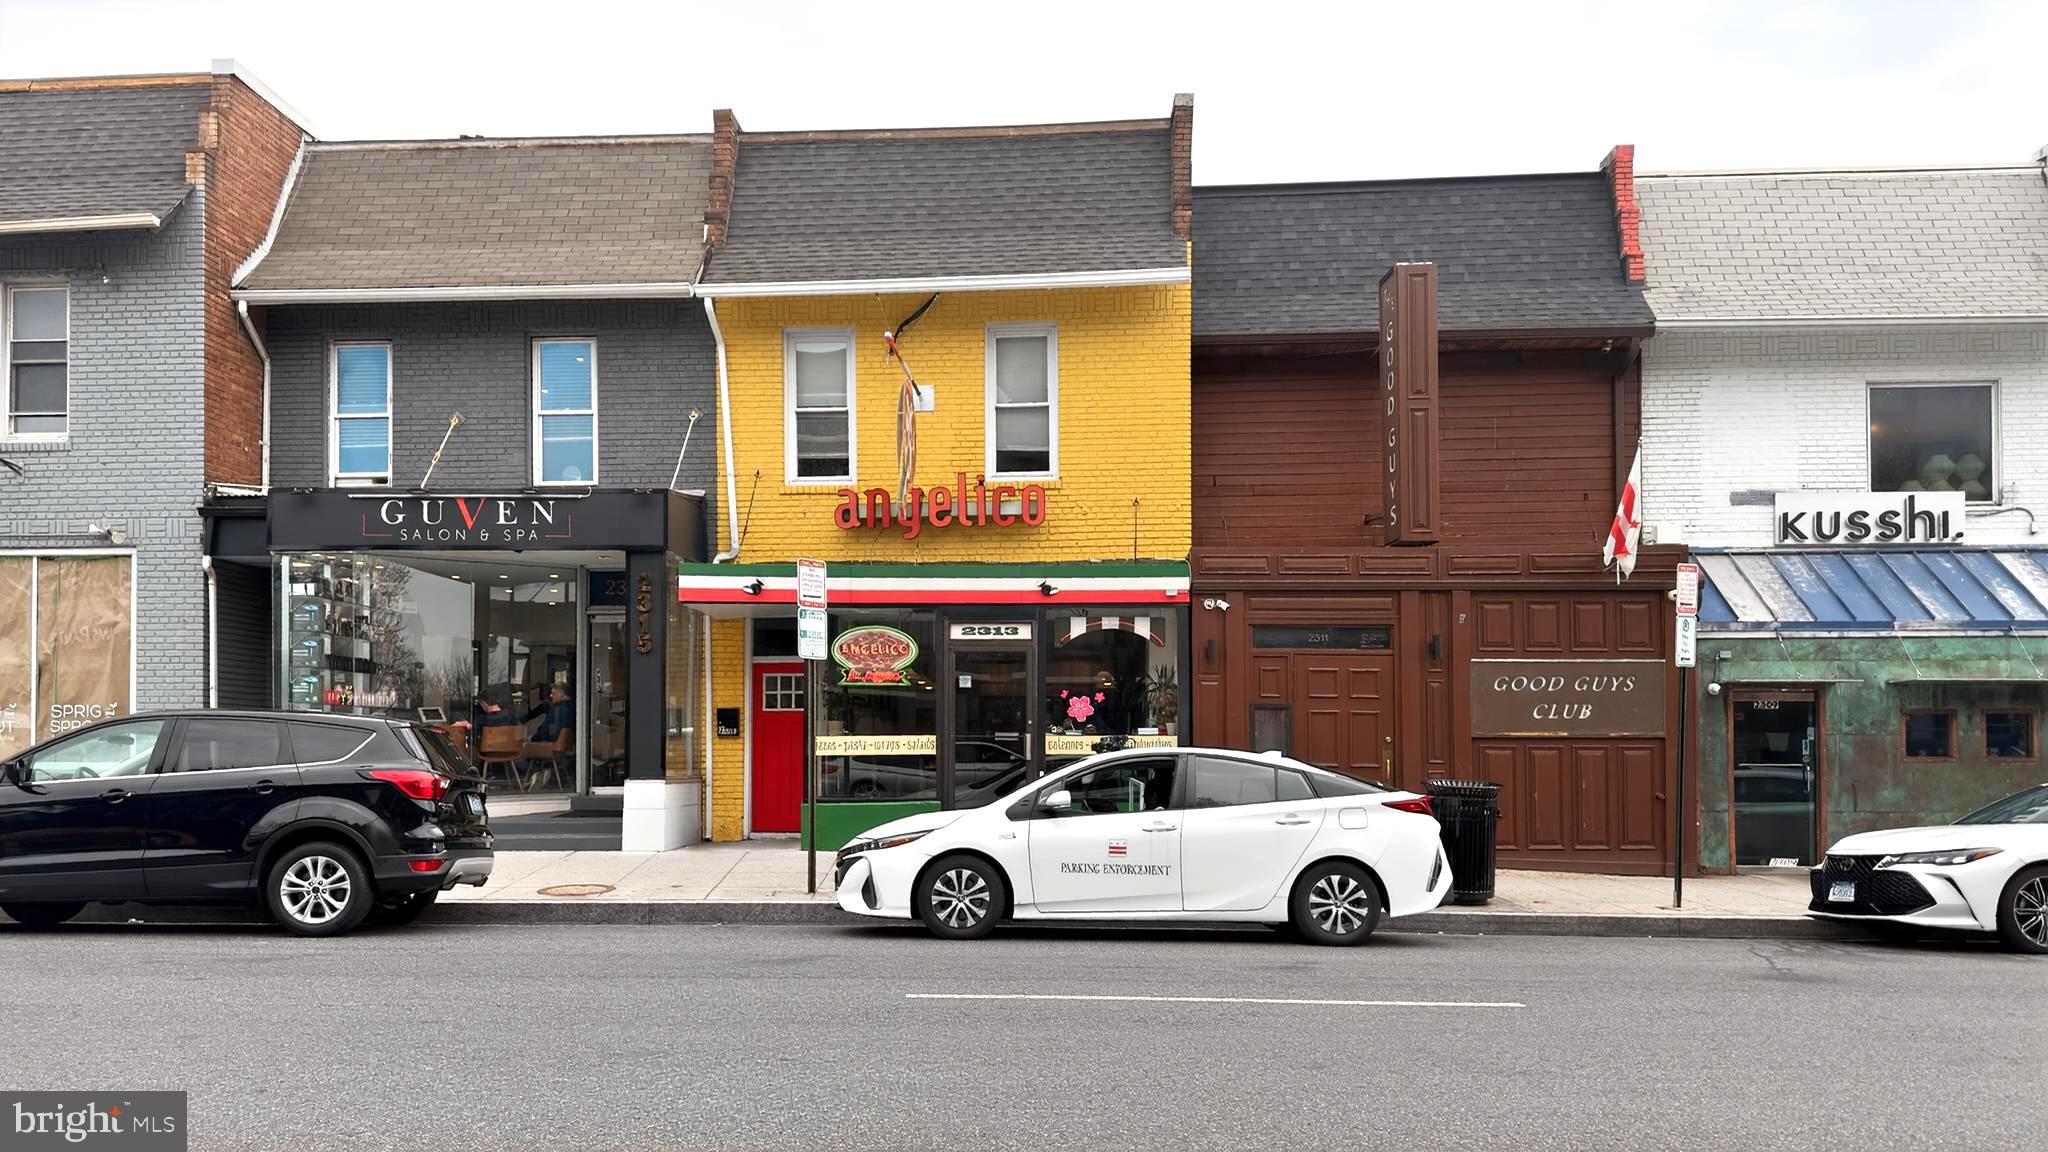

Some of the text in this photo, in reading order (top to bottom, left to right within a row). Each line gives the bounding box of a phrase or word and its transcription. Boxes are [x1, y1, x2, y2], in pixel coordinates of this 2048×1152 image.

[1385, 320, 1397, 527] GOOD GUYS
[380, 496, 556, 530] GUVEN
[834, 472, 1046, 540] angelico
[400, 528, 538, 541] SALON & SPA
[606, 580, 626, 595] 23
[961, 626, 1019, 636] 2313
[841, 642, 909, 656] ANGELICO
[1493, 675, 1636, 692] GOOD GUYS
[50, 704, 102, 719] SPRIG
[1532, 703, 1593, 719] CLUB
[1061, 862, 1172, 876] PARKING ENFORCEMENT
